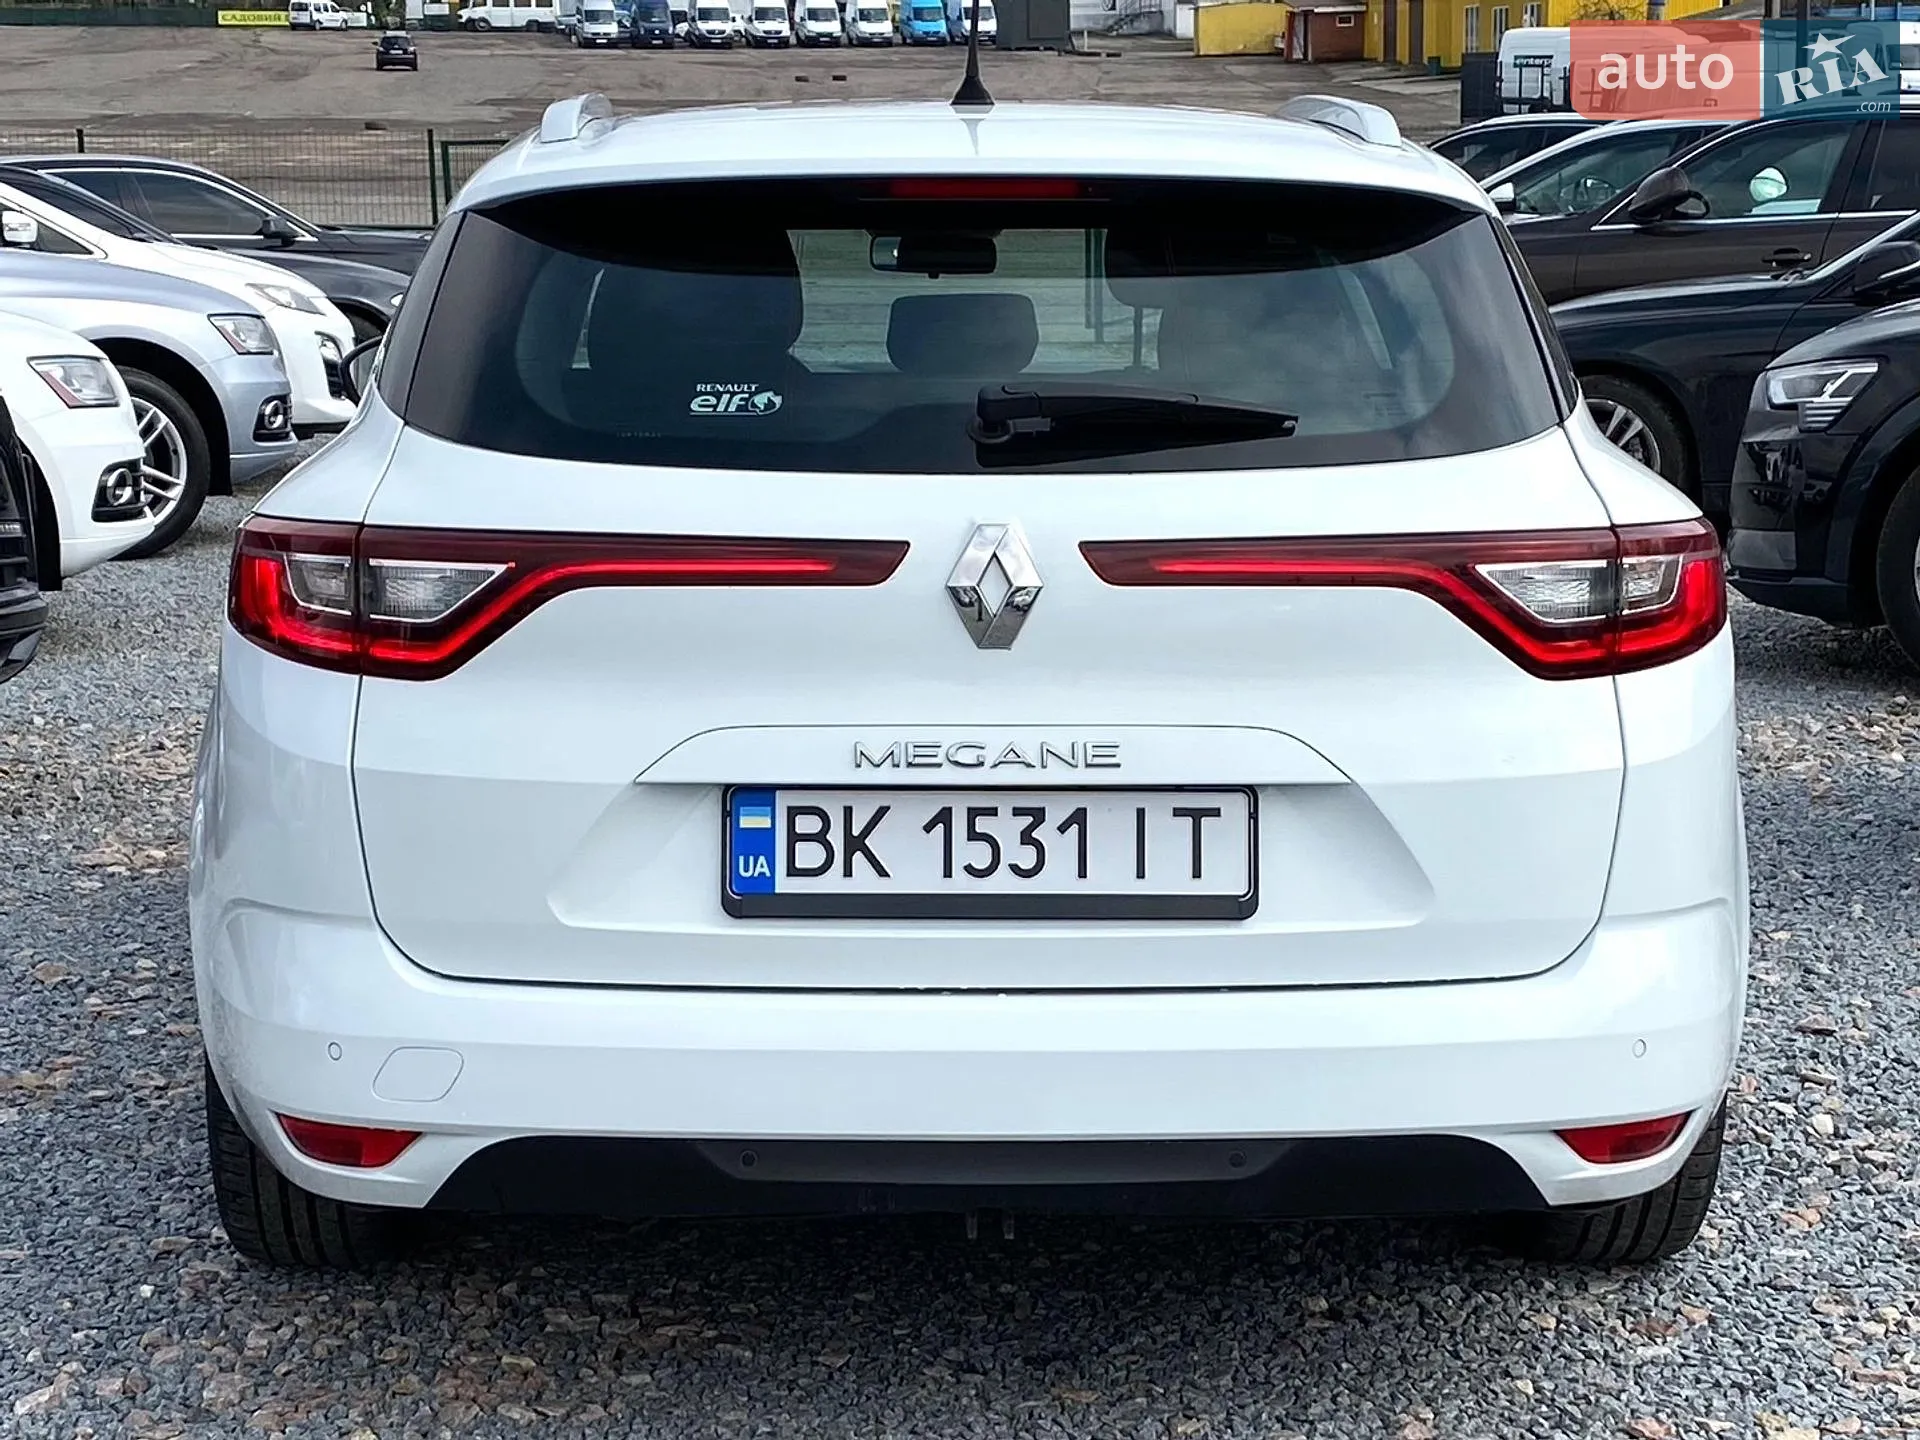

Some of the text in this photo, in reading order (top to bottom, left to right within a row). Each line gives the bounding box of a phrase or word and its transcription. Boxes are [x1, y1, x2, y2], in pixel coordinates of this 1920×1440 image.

[221, 13, 281, 22] САДОВИЙ
[696, 383, 759, 392] RENAULT
[690, 393, 749, 412] elf
[853, 741, 1122, 768] MEGANE
[785, 805, 892, 879] BK
[922, 805, 1088, 879] 1531
[739, 856, 771, 878] UA
